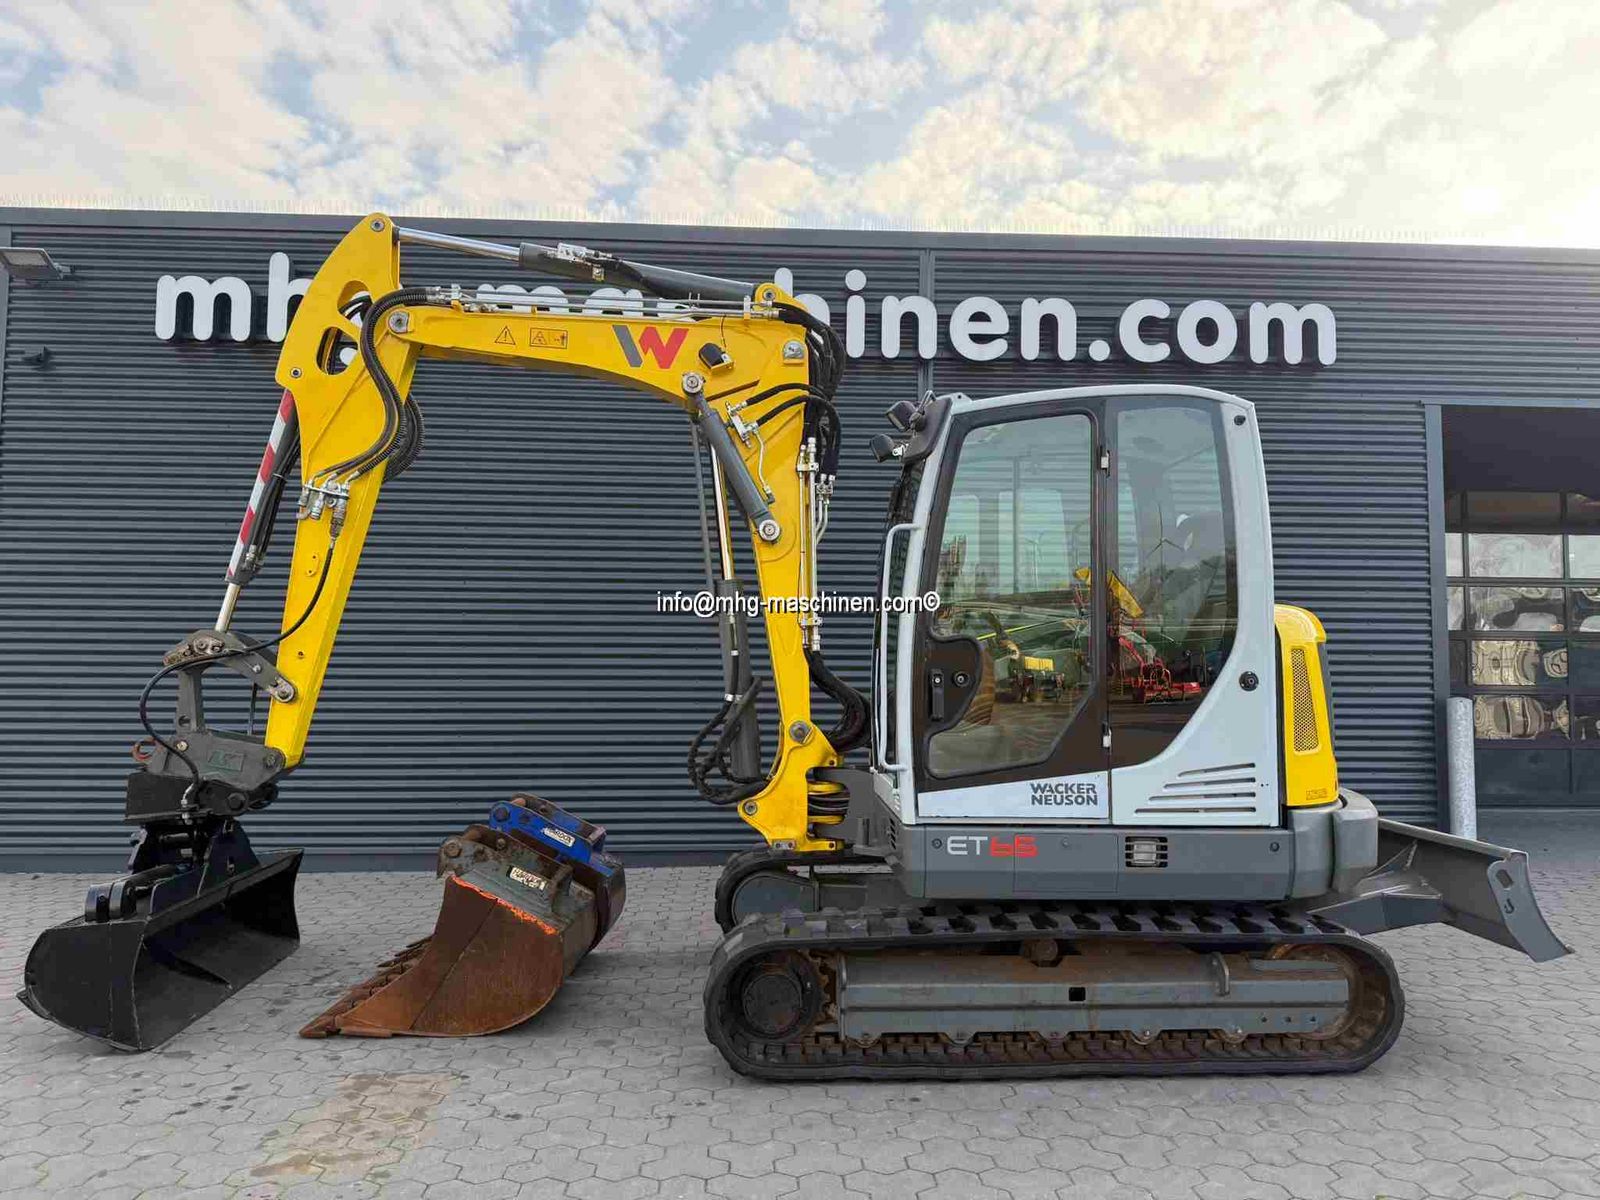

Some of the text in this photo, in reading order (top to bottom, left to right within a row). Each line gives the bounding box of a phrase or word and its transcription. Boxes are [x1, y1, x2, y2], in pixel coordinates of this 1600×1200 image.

[155, 252, 1337, 366] mhinen.com
[1030, 783, 1097, 794] WACKER
[1031, 794, 1098, 806] NEUSON
